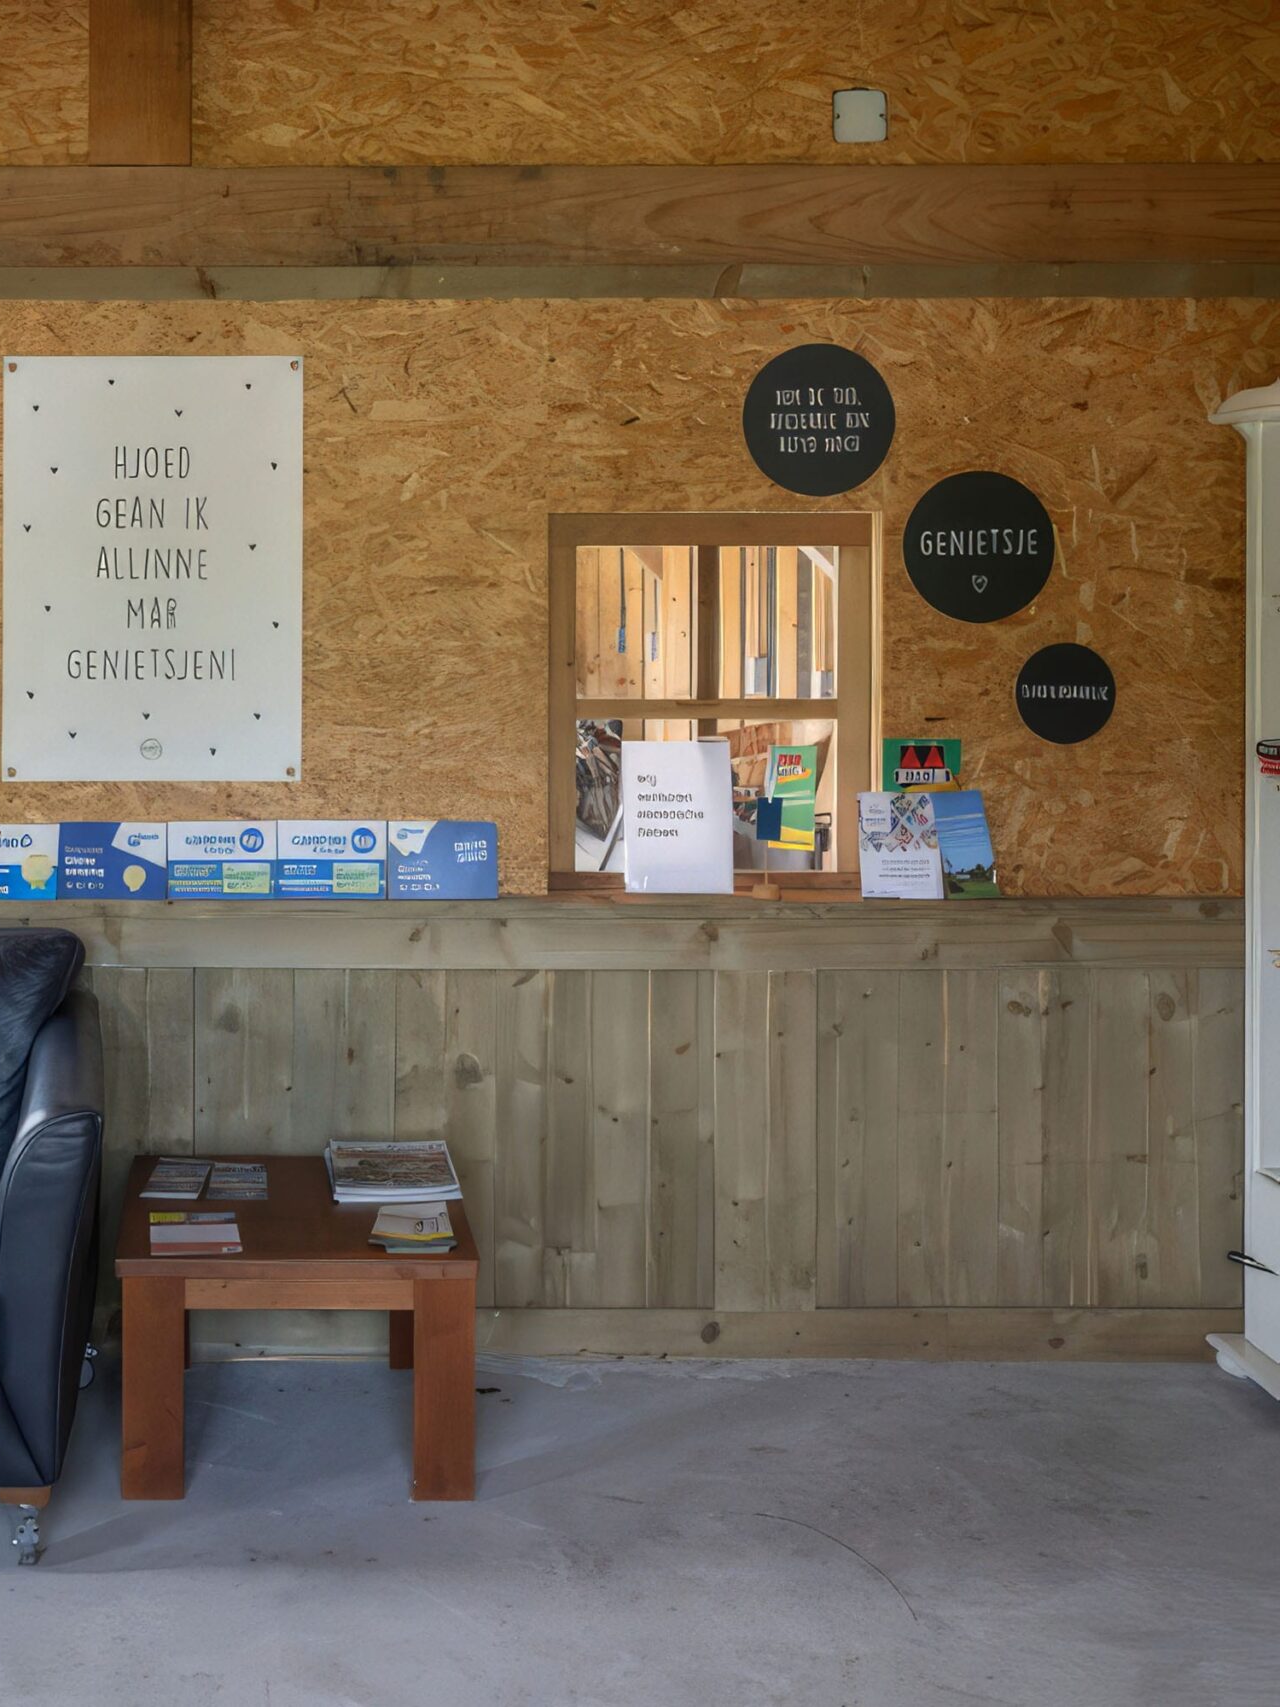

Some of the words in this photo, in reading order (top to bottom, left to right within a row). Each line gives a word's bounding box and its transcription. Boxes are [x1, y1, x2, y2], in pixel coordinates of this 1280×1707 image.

[115, 446, 190, 479] HJOED
[96, 496, 165, 529] GEAN
[185, 497, 209, 530] IK
[920, 528, 1039, 556] GENIETSJE
[97, 546, 208, 580] ALLINNE
[127, 597, 177, 630] MAR
